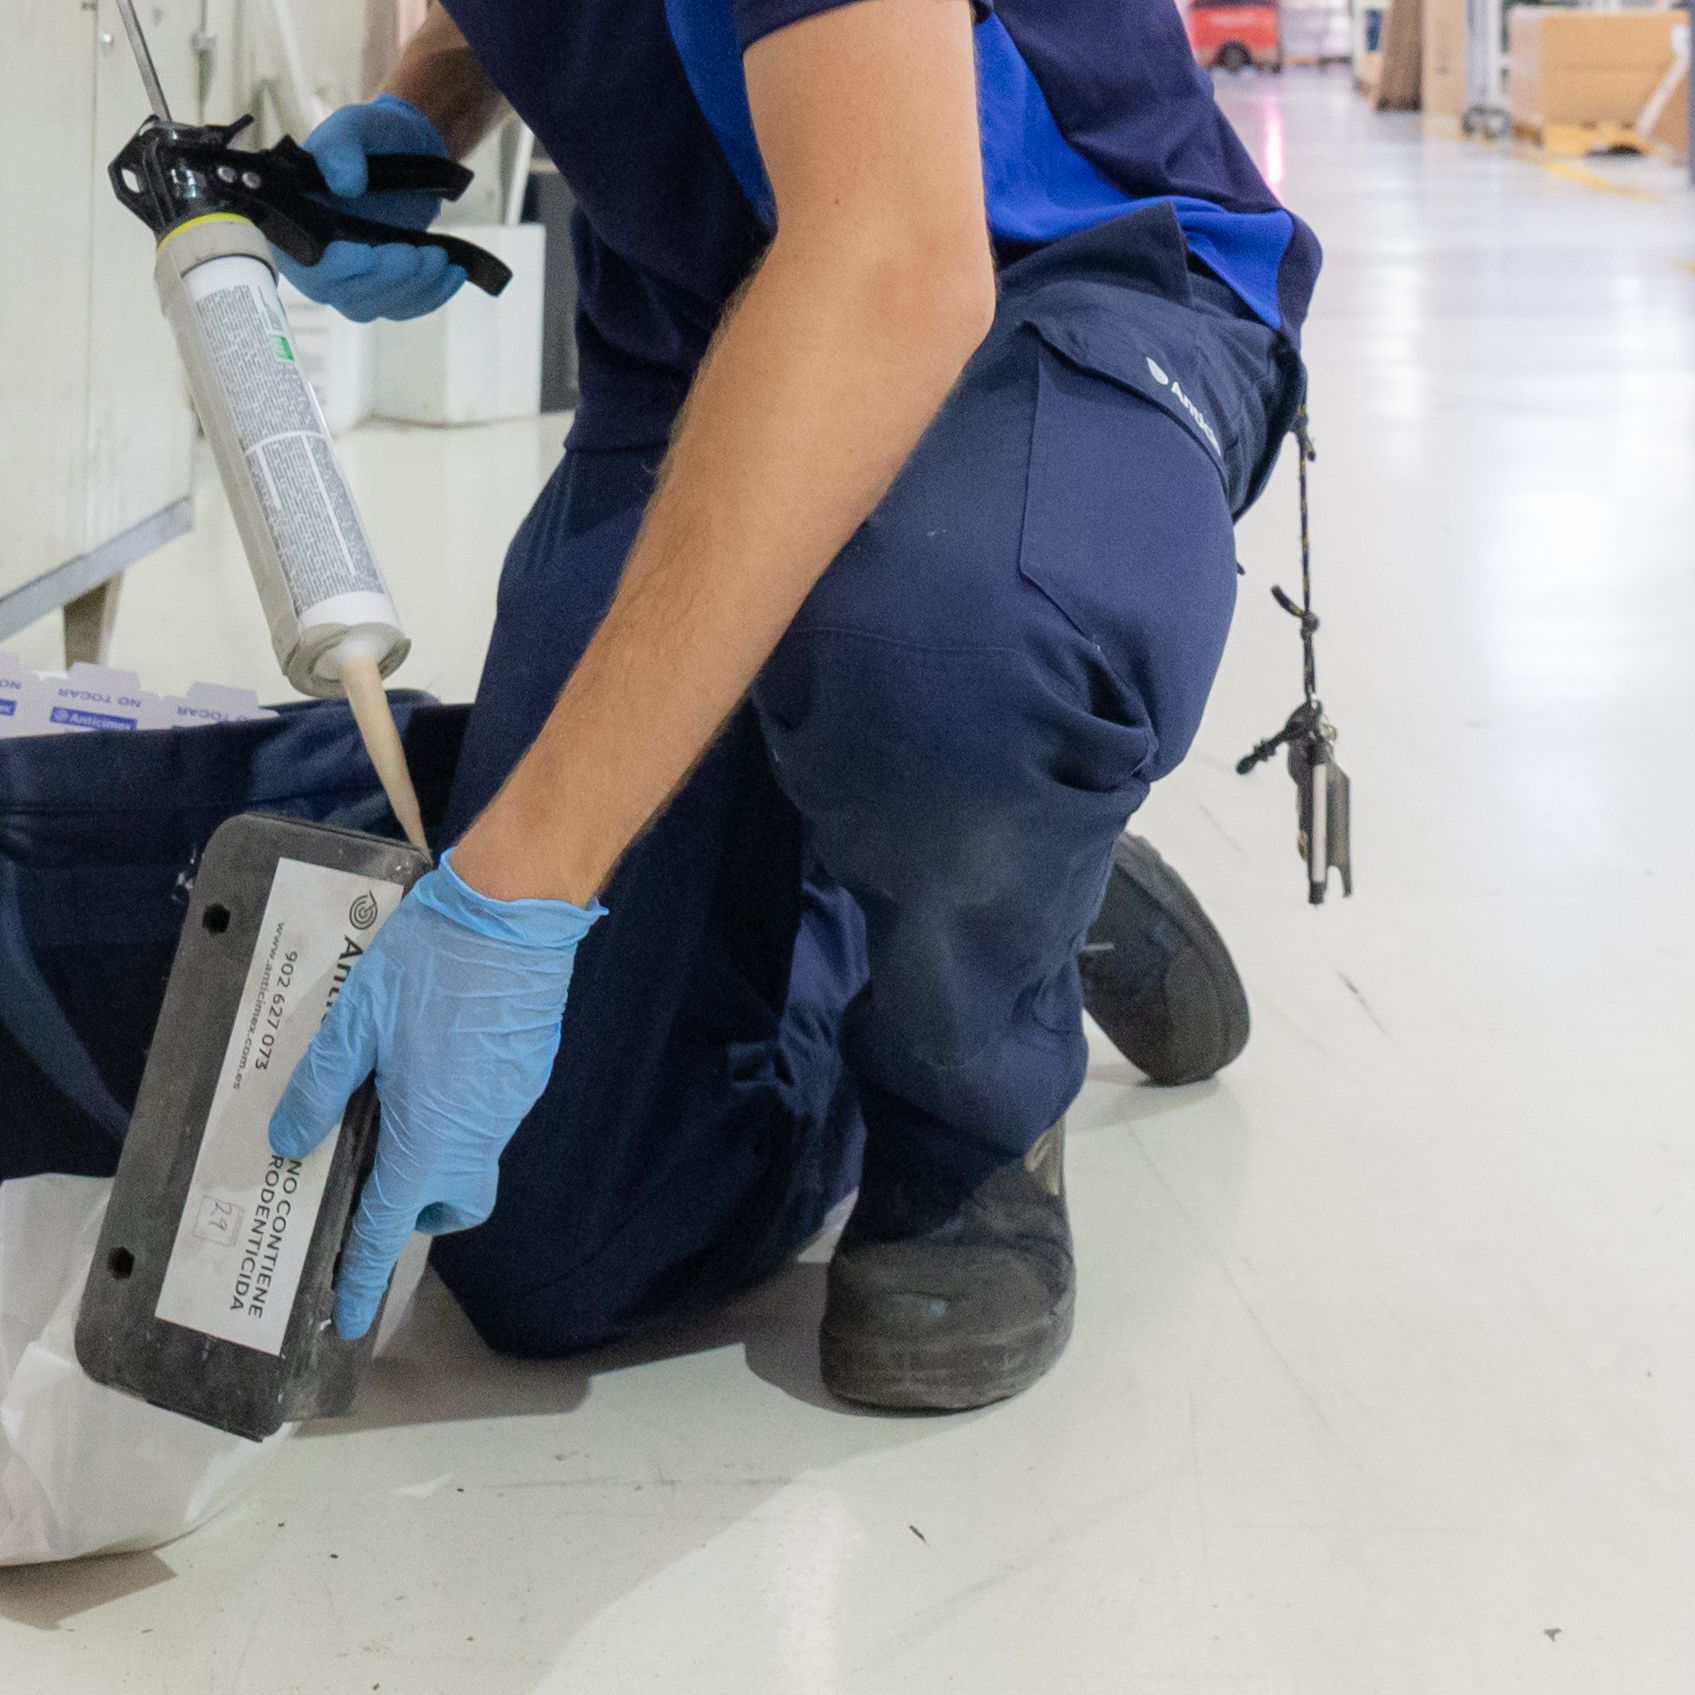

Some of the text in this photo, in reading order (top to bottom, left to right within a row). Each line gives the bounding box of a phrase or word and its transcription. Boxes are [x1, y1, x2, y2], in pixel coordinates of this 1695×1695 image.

[57, 687, 142, 709] NO TOCAR
[233, 921, 285, 1090] www.anticimex.com.es
[255, 950, 299, 1071] 902 627 073
[229, 1154, 284, 1312] RODENTICIDA
[248, 1158, 303, 1319] NO CONTIENE
